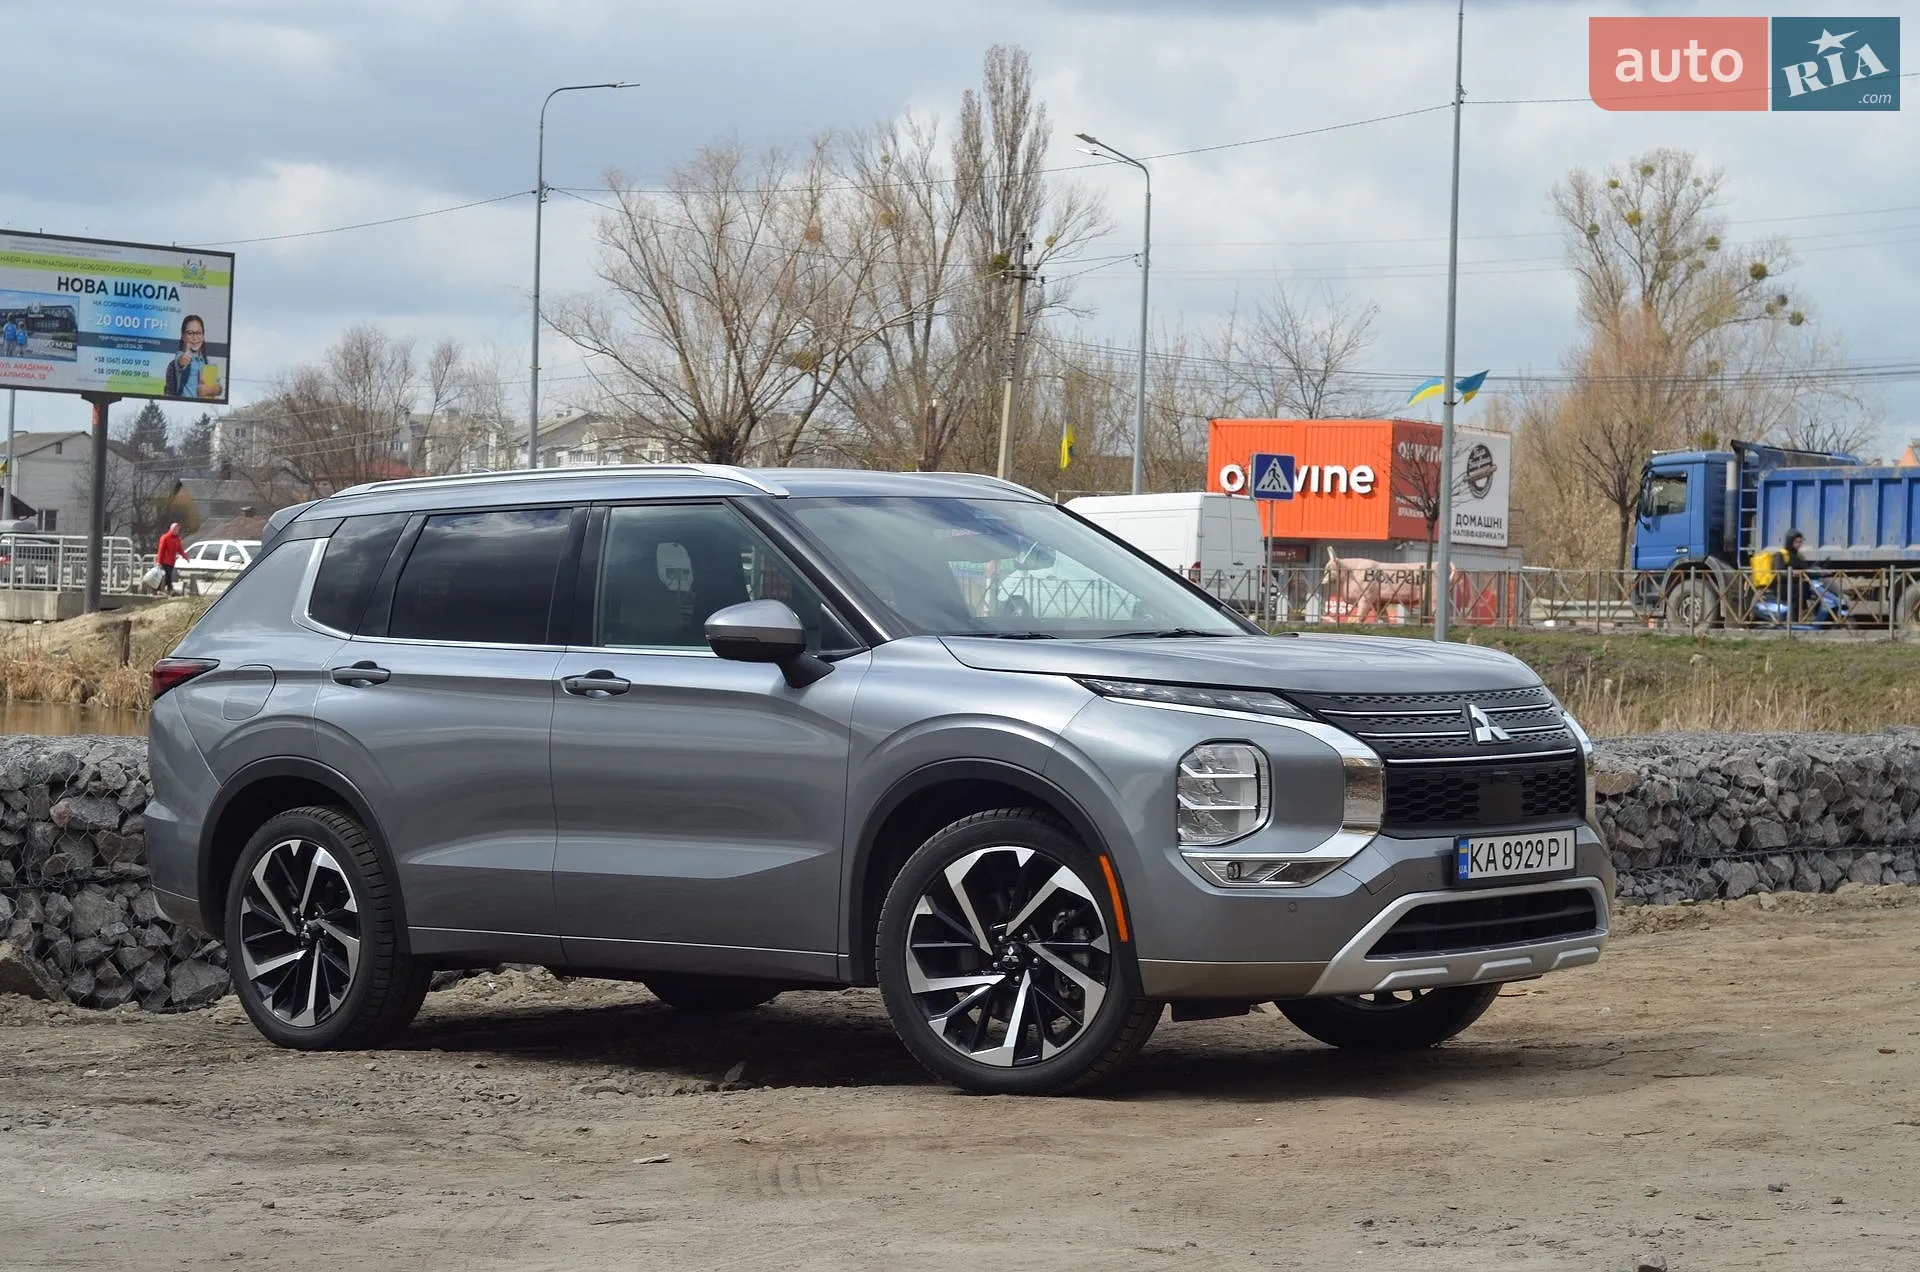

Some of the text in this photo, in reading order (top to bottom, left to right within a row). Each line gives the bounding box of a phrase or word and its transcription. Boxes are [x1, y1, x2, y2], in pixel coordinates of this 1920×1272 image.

[58, 276, 180, 301] НОВА ШКОЛА
[115, 315, 141, 329] 000
[143, 317, 168, 330] ГРН
[1455, 513, 1503, 529] ДОМАШНІ
[1470, 842, 1498, 873] KA
[1502, 839, 1544, 870] 8929
